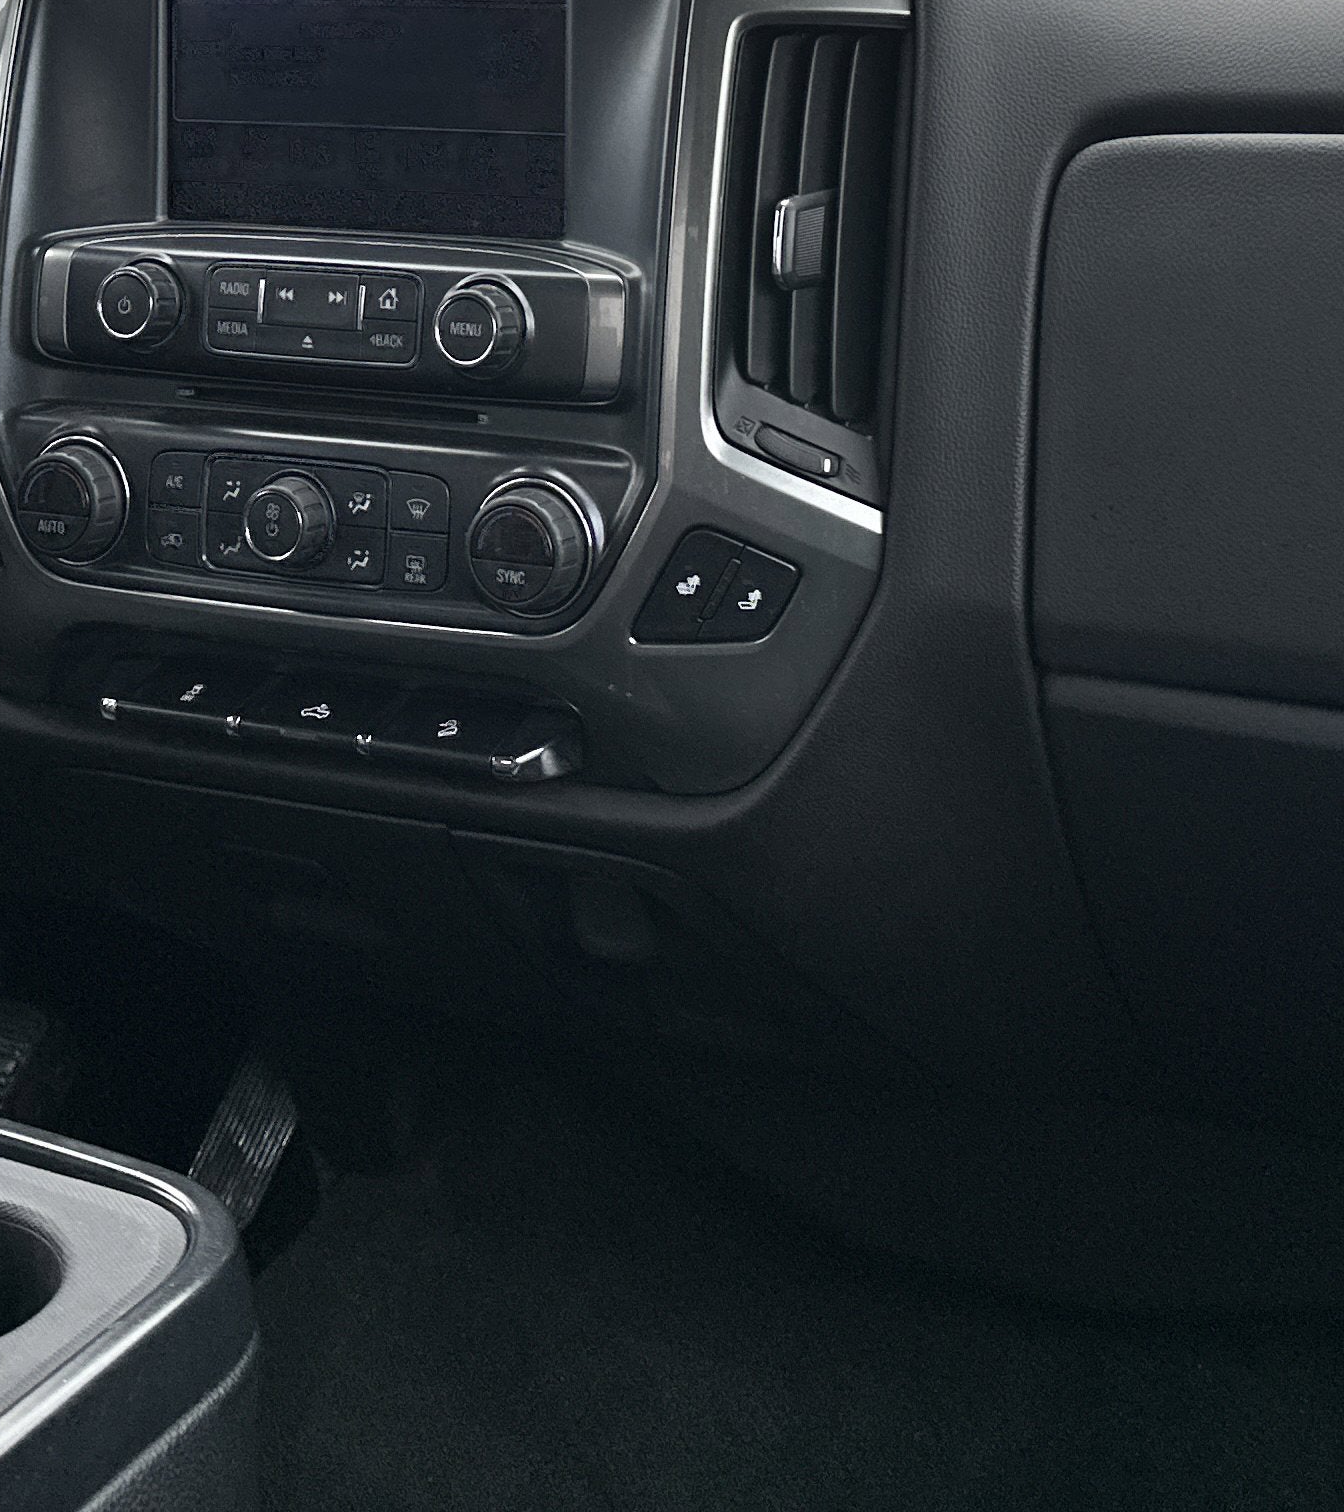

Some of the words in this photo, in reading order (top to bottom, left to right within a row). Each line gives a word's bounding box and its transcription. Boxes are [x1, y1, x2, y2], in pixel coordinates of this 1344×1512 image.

[219, 281, 249, 297] RADIO
[216, 320, 248, 337] MEDIA
[448, 322, 483, 338] MENU
[375, 333, 404, 349] BACK
[165, 473, 184, 490] A/C
[37, 519, 65, 535] AUTO
[403, 571, 427, 586] REAR
[494, 566, 526, 589] SYNC
